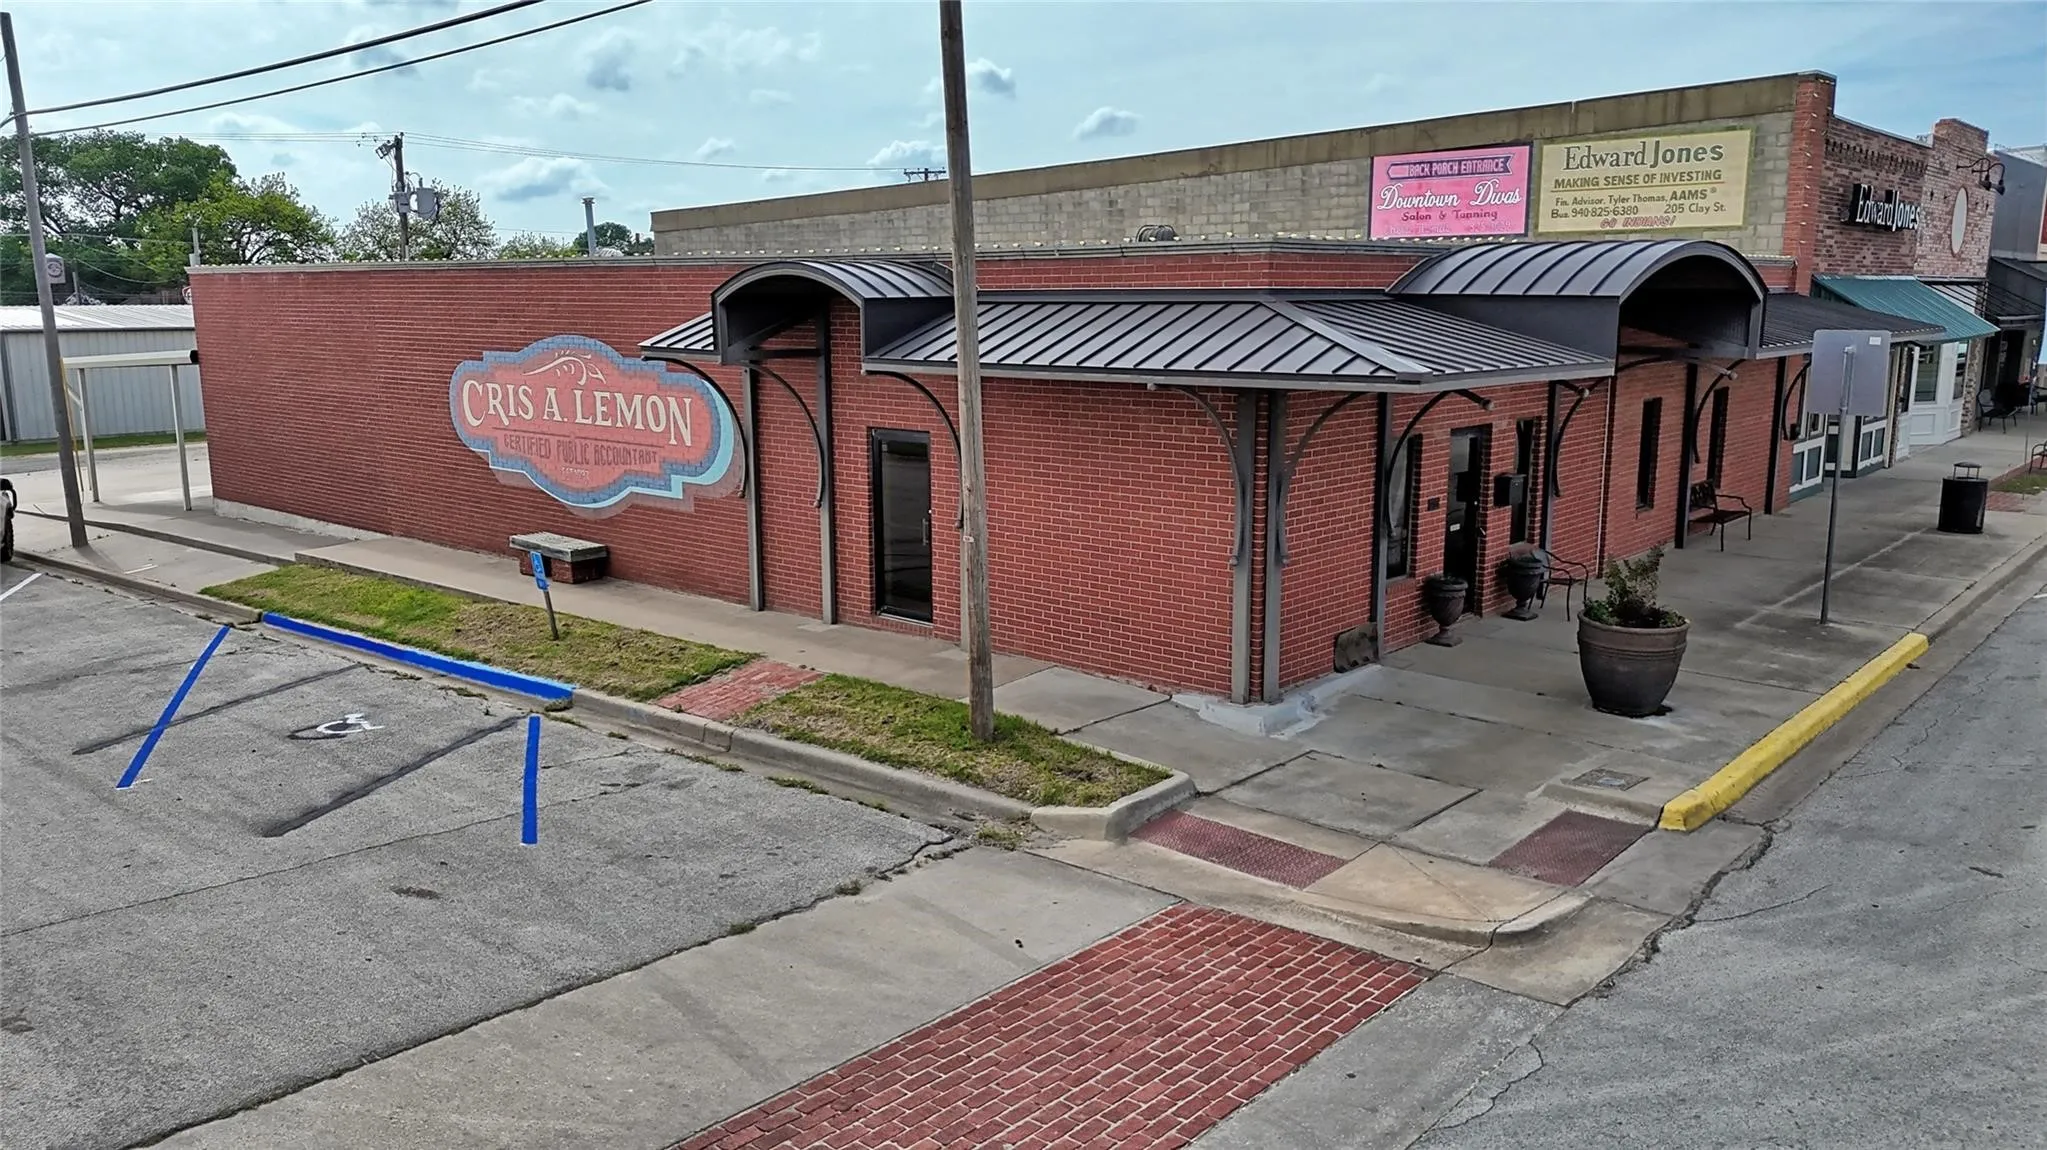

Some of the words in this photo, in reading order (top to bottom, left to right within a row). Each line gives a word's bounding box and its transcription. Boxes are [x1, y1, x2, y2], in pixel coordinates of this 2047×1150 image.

[1563, 141, 1647, 170] Edward
[1650, 140, 1724, 168] Jones
[1409, 164, 1430, 176] BACK
[1432, 162, 1458, 176] PORCH
[1461, 158, 1504, 174] ENTRANCE
[1554, 177, 1599, 189] MAKING
[1604, 174, 1639, 186] SENSE
[1643, 173, 1657, 184] OF
[1660, 169, 1722, 183] INVESTING
[1377, 183, 1460, 209] Downtown
[1470, 178, 1522, 206] Divas
[1608, 194, 1630, 207] Tyler
[1401, 211, 1431, 221] Salon
[1439, 212, 1446, 220] &
[1452, 209, 1498, 221] Tanning
[1664, 203, 1684, 214] 205
[1688, 202, 1710, 215] Clay
[1713, 201, 1726, 212] St.
[1856, 184, 1895, 226] Edward
[1892, 190, 1920, 232] Jones
[1600, 218, 1617, 229] GO
[462, 379, 534, 427] CRIS
[543, 387, 568, 422] A.
[573, 389, 692, 446] LEMON
[504, 434, 550, 459] CERTIFIED
[557, 439, 590, 465] PUBLIC
[594, 445, 657, 466] ACCOUNTANT
